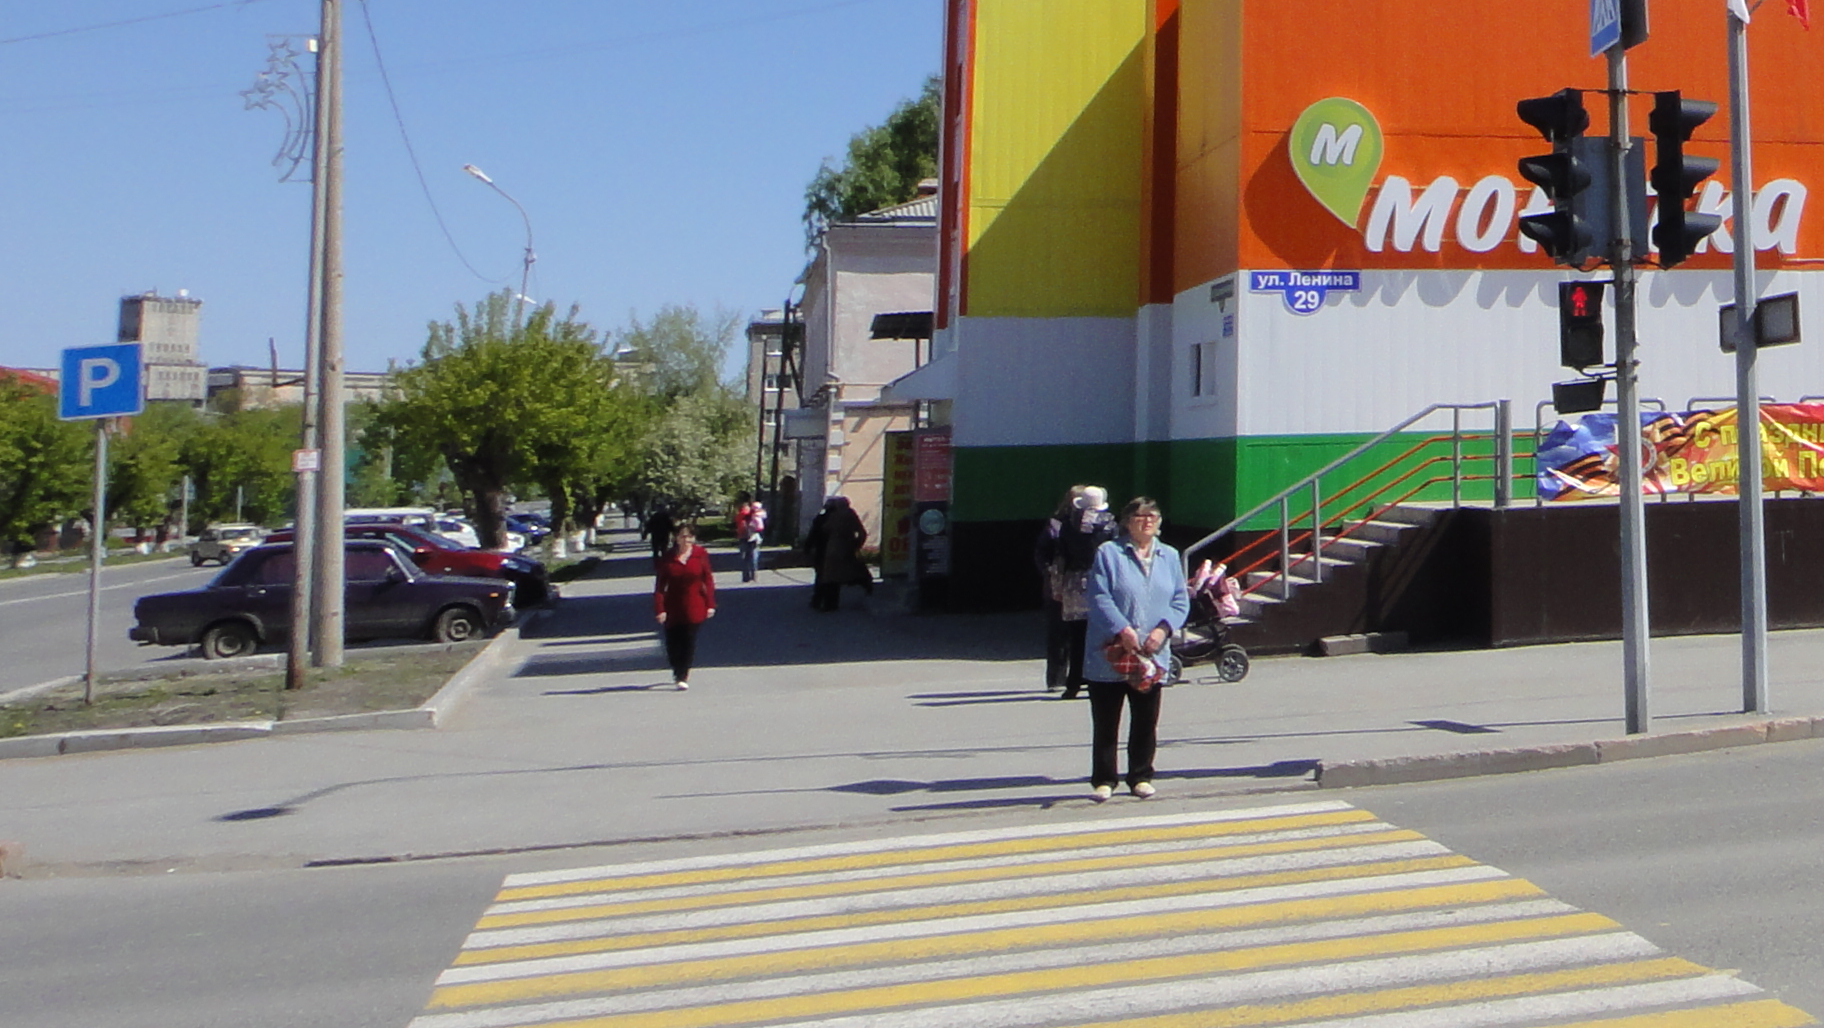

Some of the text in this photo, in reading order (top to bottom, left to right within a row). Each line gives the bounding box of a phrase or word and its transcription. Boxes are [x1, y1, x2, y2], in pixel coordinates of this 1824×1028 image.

[1257, 272, 1354, 289] ул. Ленина
[1294, 290, 1320, 309] 29
[1694, 421, 1712, 448] С
[1670, 450, 1790, 486] Велиой
